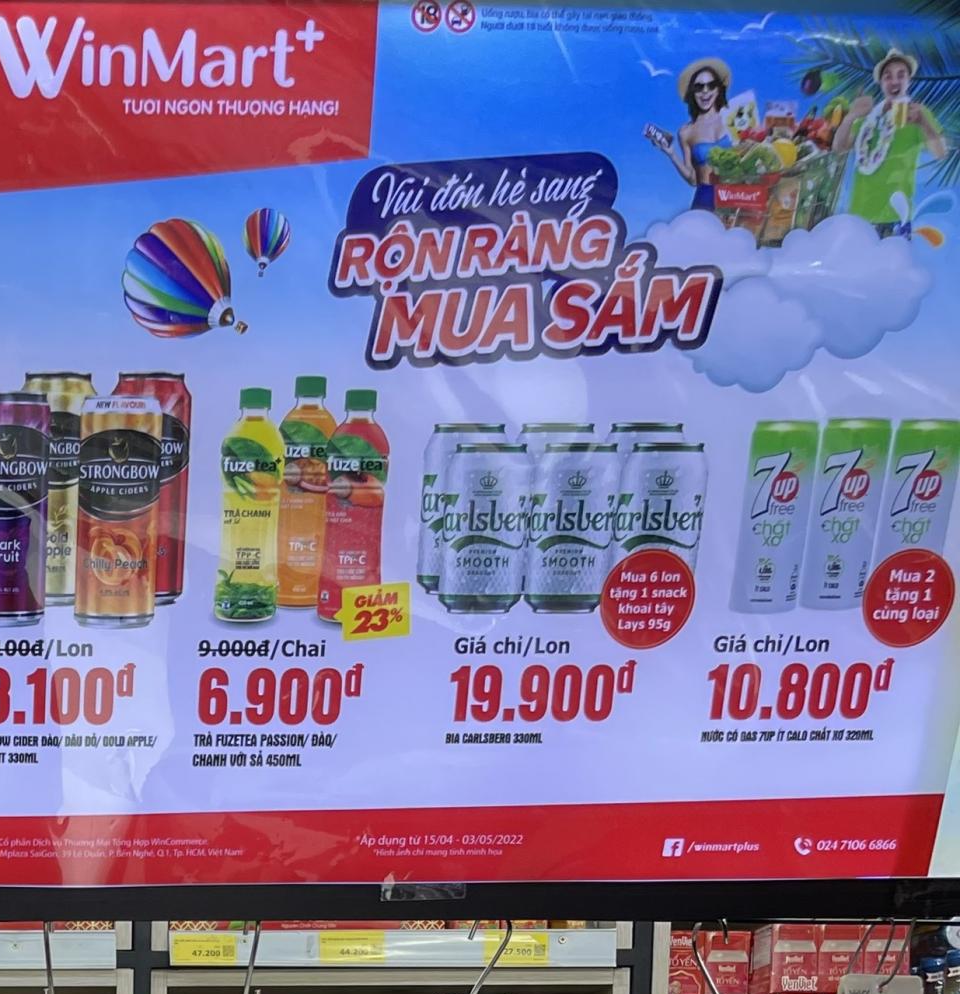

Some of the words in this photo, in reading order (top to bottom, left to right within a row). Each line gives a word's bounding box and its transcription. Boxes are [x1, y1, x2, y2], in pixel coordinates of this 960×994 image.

[372, 172, 426, 219] Vui
[429, 169, 484, 212] đón
[491, 167, 527, 208] hè
[531, 168, 603, 217] sang
[338, 220, 455, 291] RỘN
[460, 212, 614, 274] RÀNG
[372, 283, 531, 358] MUA
[544, 250, 712, 346] SẮM
[80, 464, 160, 480] STRONGBOW
[456, 557, 510, 568] SMOOTH
[542, 557, 596, 568] SMOOTH
[620, 571, 647, 583] Mua
[650, 572, 658, 582] 6
[661, 571, 681, 583] lon
[889, 569, 921, 583] Mua
[925, 570, 936, 583] 2
[354, 588, 399, 608] GIẢM
[609, 587, 638, 600] tặng
[641, 588, 648, 598] 1
[651, 587, 688, 599] snack
[885, 588, 919, 605] tặng
[923, 589, 932, 601] 1
[618, 603, 653, 615] khoai
[654, 603, 674, 617] tây
[872, 606, 908, 621] cùng
[911, 605, 940, 623] loại
[351, 608, 404, 635] 23%
[617, 618, 646, 632] Lays
[647, 619, 672, 632] 95g
[454, 636, 487, 655] Giá
[492, 634, 571, 656] chỉ/Lon
[713, 635, 747, 653] Giá
[753, 633, 831, 654] chỉ/Lon
[197, 662, 365, 727] 6.900đ
[449, 659, 638, 723] 19.900đ
[706, 657, 896, 721] 10.800đ
[193, 731, 213, 747] TRÀ
[215, 734, 258, 747] FUZETEA
[260, 733, 309, 748] PASSION/
[445, 733, 461, 744] BIA
[463, 733, 511, 744] CARLSBERG
[512, 733, 543, 744] 330ML
[7, 751, 39, 764] 330ML
[192, 753, 227, 767] CHANH
[249, 750, 263, 767] SẢ
[265, 753, 302, 767] 450ML
[360, 834, 376, 846] Áp
[378, 834, 407, 848] dụng
[409, 834, 421, 845] từ
[423, 834, 453, 846] 15/04
[462, 834, 524, 845] 03/05/2022
[687, 841, 760, 853] /winmartplus
[816, 840, 839, 851] 024
[840, 839, 867, 851] 7106
[868, 839, 897, 851] 6866
[191, 949, 221, 957] 47.200
